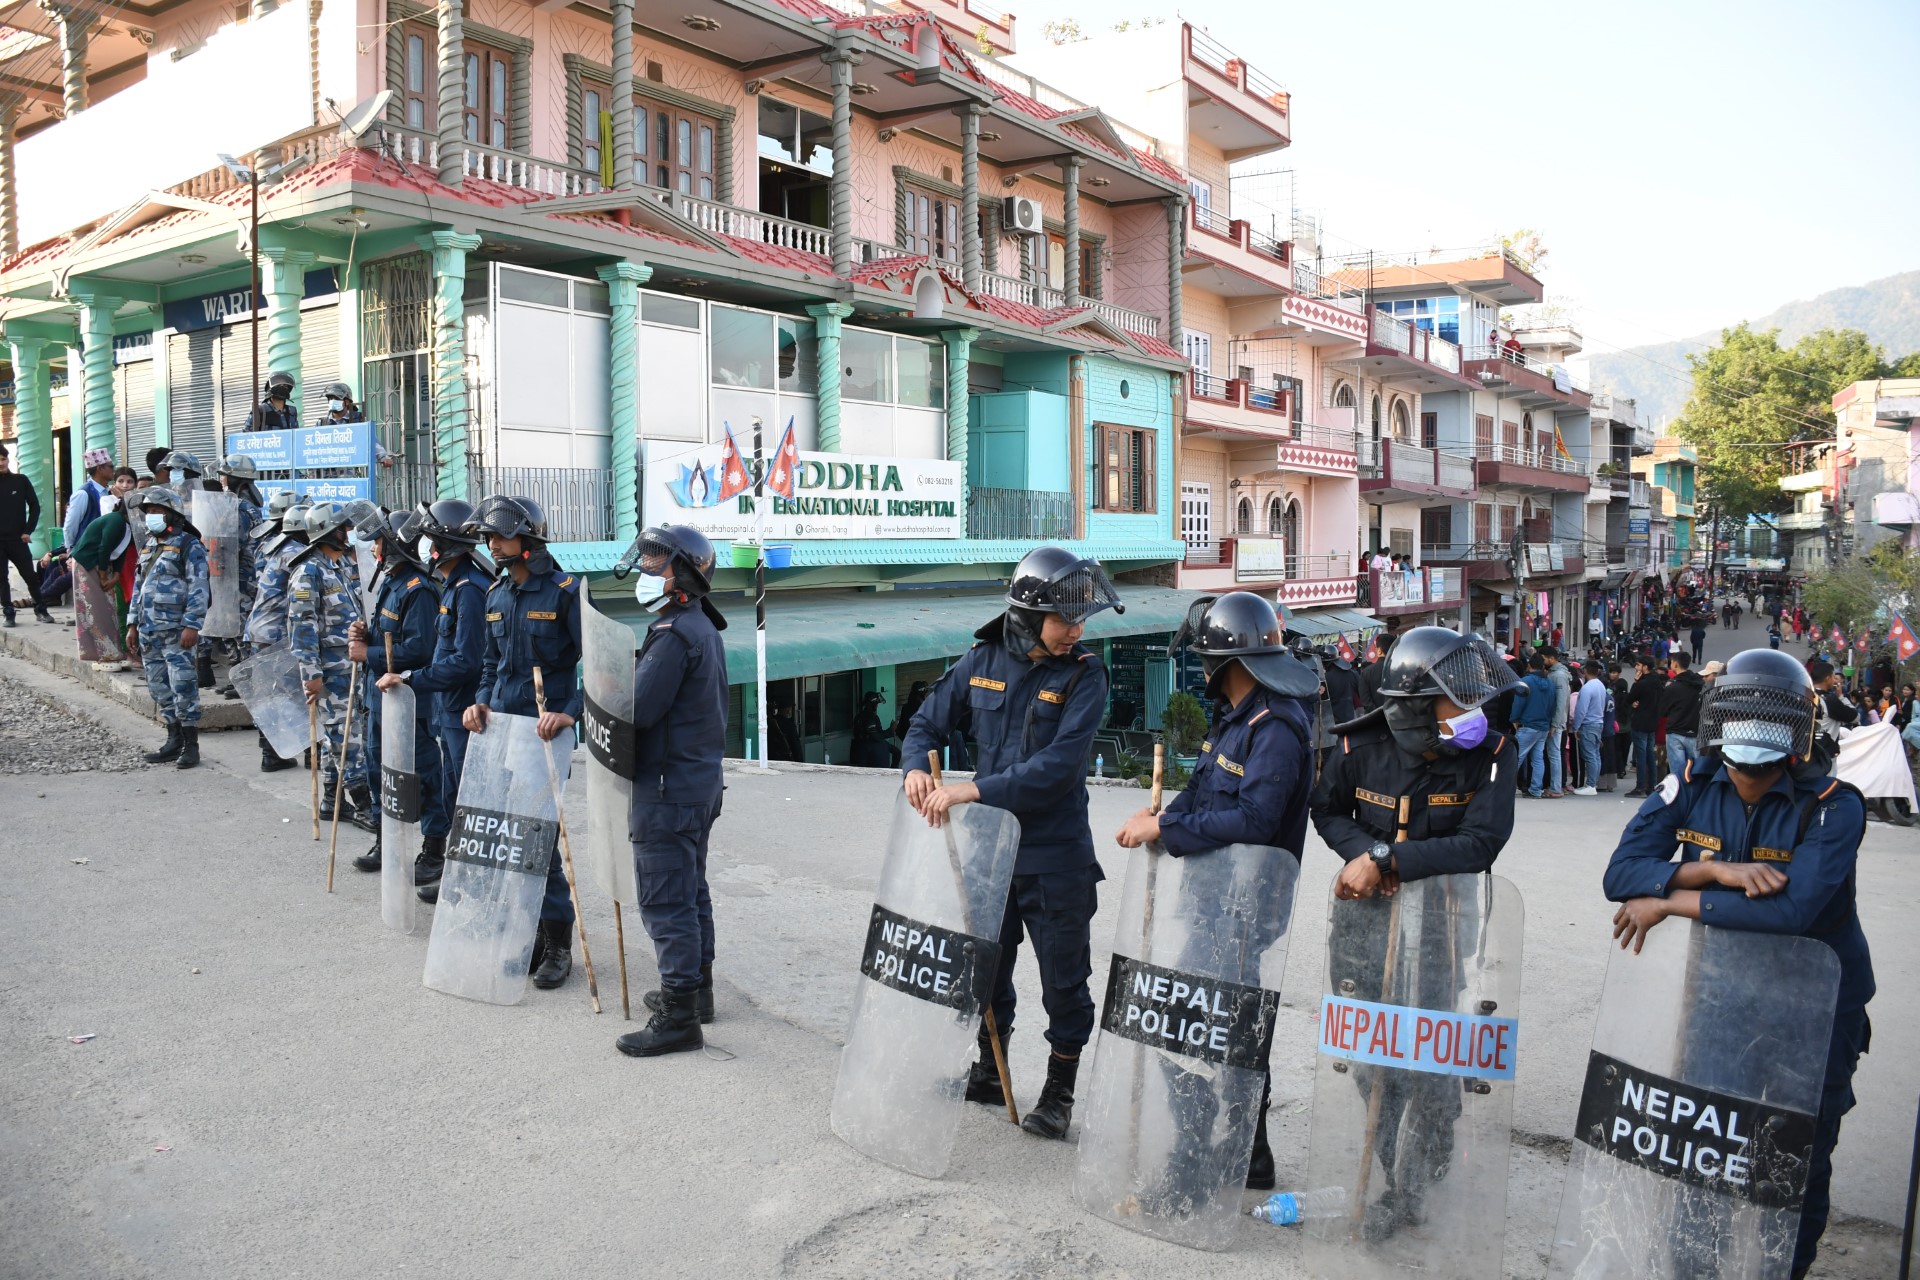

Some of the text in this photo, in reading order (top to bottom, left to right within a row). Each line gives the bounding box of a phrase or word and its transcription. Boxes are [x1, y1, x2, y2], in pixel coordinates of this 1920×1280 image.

[743, 457, 904, 491] DDHA
[738, 495, 957, 518] INERNATIONAL HOSPITAL
[832, 524, 848, 535] Dang
[382, 771, 397, 791] PAL
[382, 791, 398, 812] LICE
[464, 813, 523, 840] NEPAL
[458, 837, 523, 864] POLICE
[1757, 850, 1778, 859] NEPAL
[881, 919, 952, 963] NEPAL
[874, 949, 951, 994] POLICE
[1133, 971, 1229, 1017] NEPAL
[1125, 1004, 1229, 1051] POLICE
[1324, 1002, 1509, 1070] NEPAL POLICE
[1621, 1078, 1749, 1144] NEPAL
[1611, 1116, 1749, 1185] POLICE
